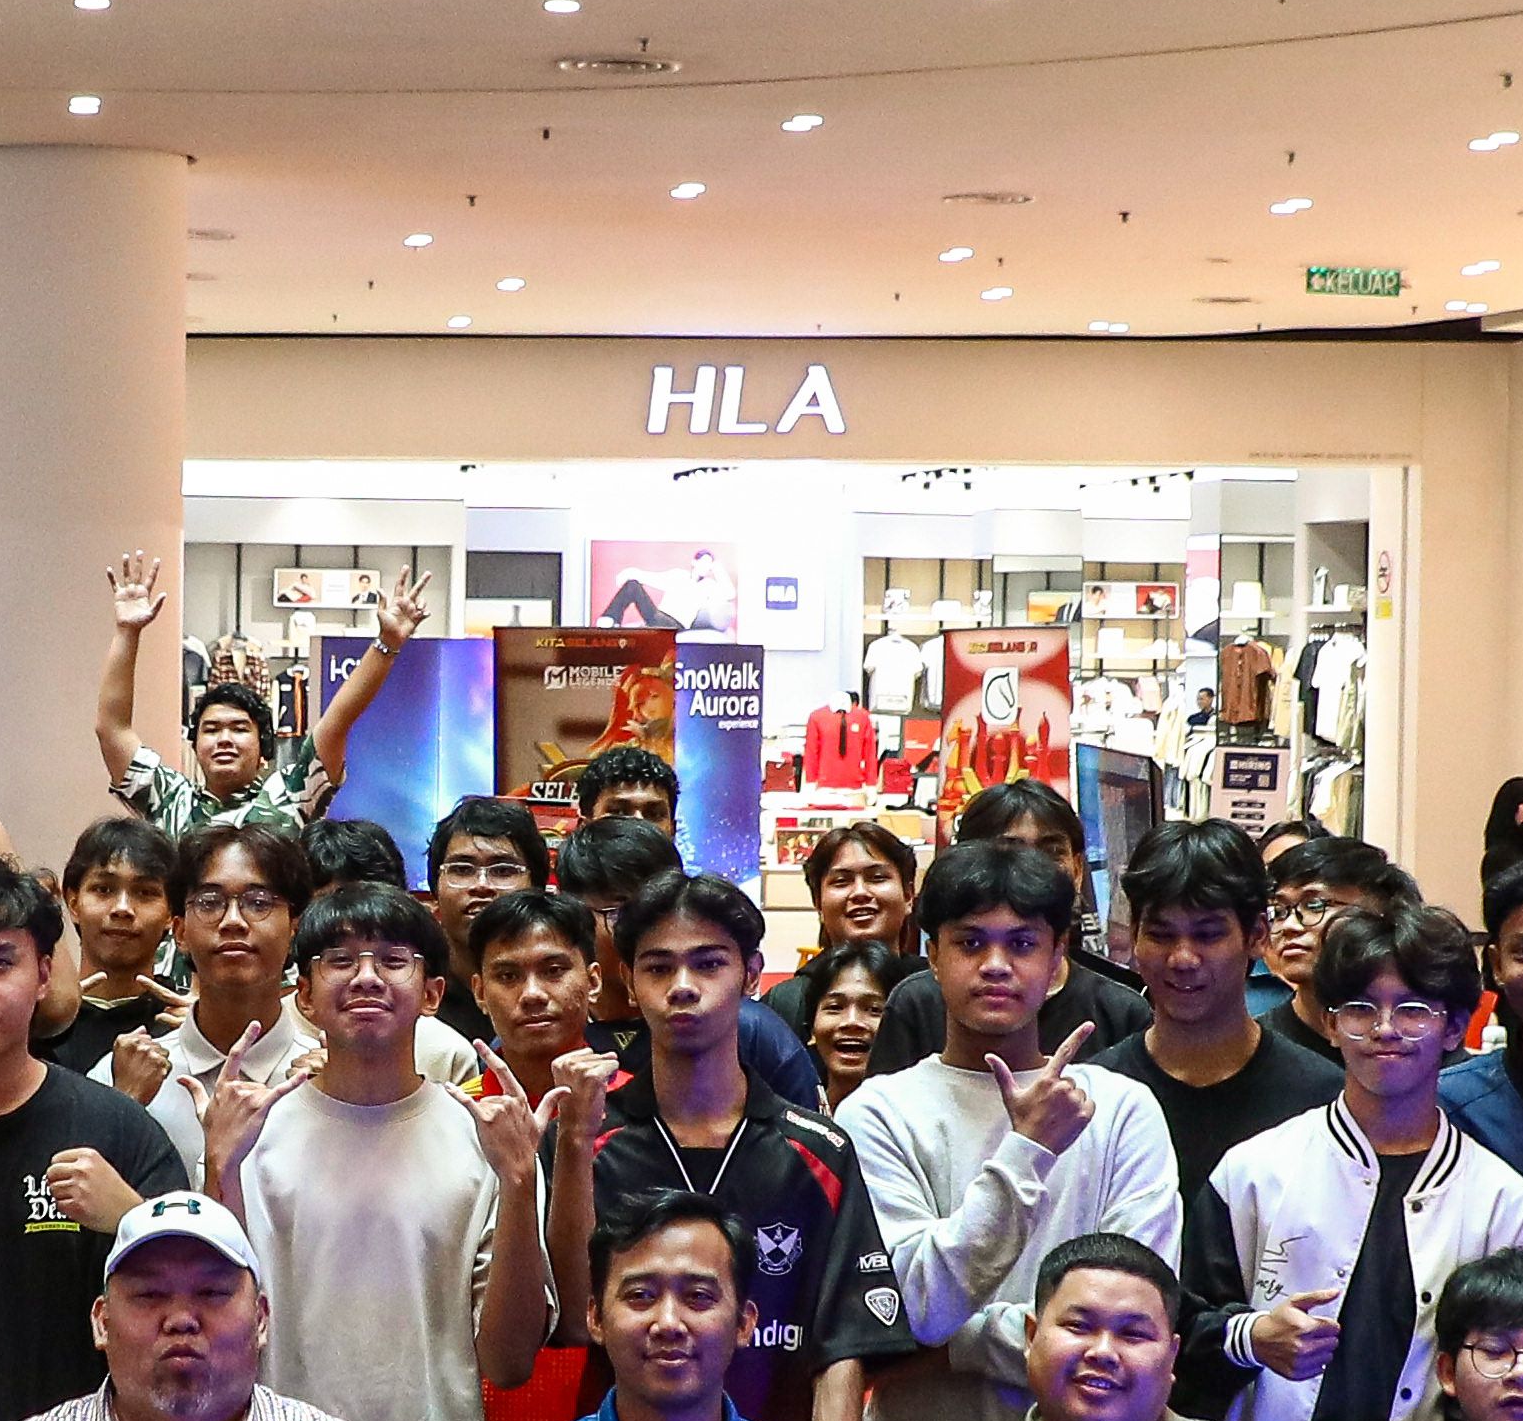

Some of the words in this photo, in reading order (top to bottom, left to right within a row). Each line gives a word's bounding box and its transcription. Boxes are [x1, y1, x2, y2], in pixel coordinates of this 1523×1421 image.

[1325, 271, 1399, 295] KELUAR
[645, 364, 847, 435] HLA
[674, 662, 761, 690] SnoWalk
[689, 689, 760, 717] Aurora
